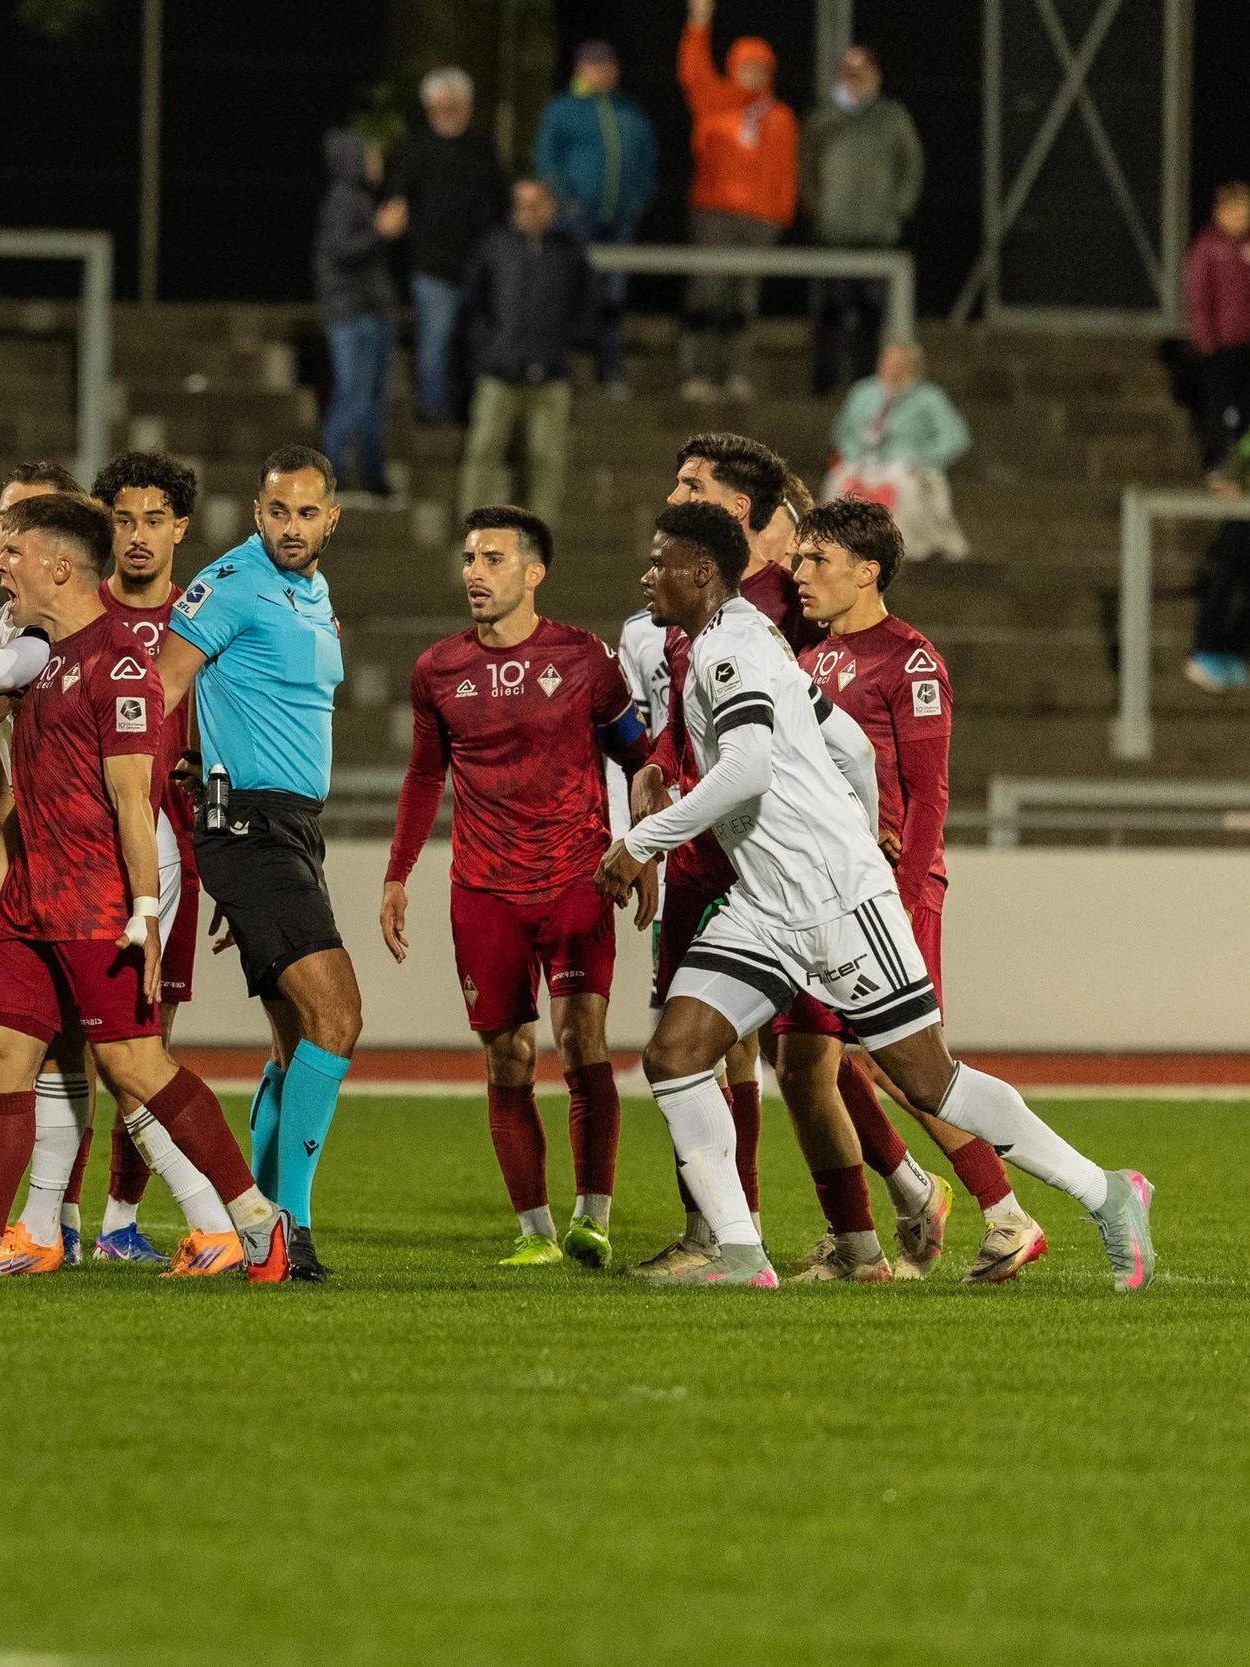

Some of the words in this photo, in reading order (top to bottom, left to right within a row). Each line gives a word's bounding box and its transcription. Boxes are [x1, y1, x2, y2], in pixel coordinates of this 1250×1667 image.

[176, 601, 191, 614] SFL
[486, 660, 530, 688] 10'
[491, 684, 525, 697] dieci
